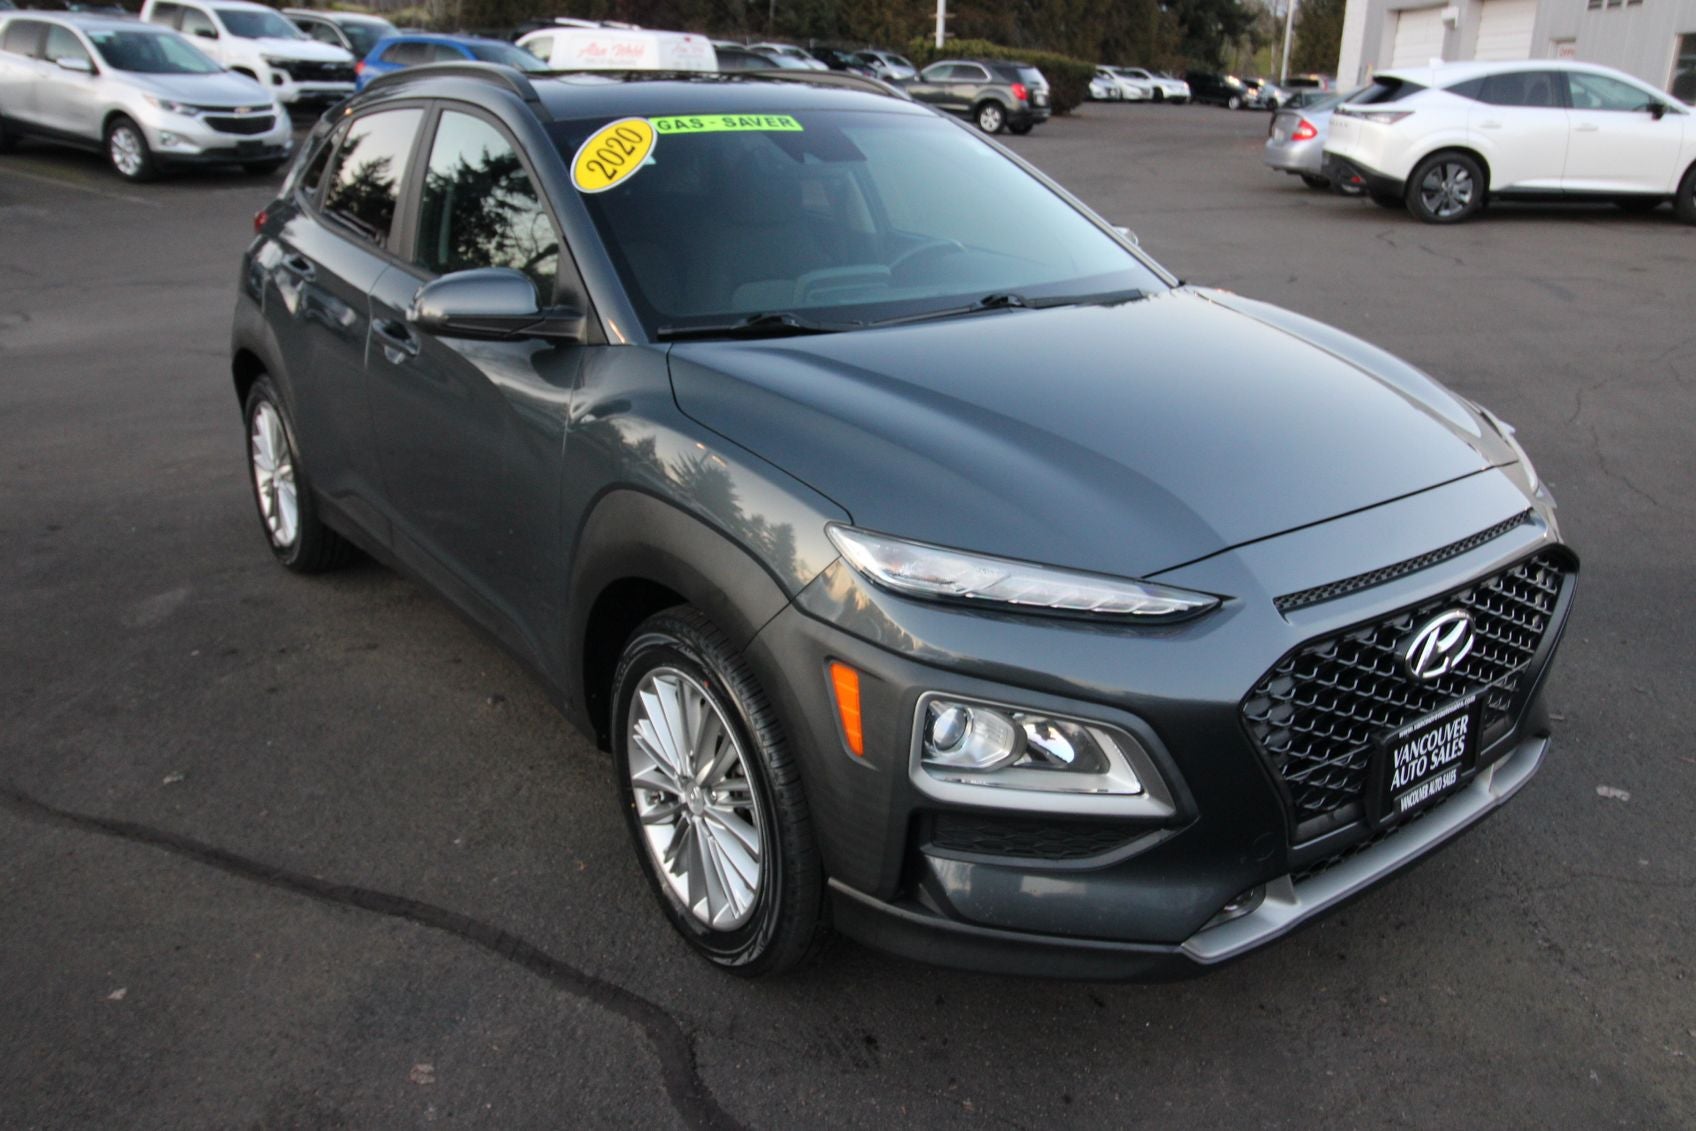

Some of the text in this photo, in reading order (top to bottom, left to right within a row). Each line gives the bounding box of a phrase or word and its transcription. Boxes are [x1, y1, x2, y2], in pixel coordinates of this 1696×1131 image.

[657, 119, 704, 130] GAS
[721, 117, 795, 128] SAVER
[586, 126, 643, 180] 2020
[1390, 735, 1465, 791] AUTO SALES
[1394, 714, 1469, 769] VANCOUVER
[1400, 768, 1457, 811] VANCOUVER AUTO SALES
